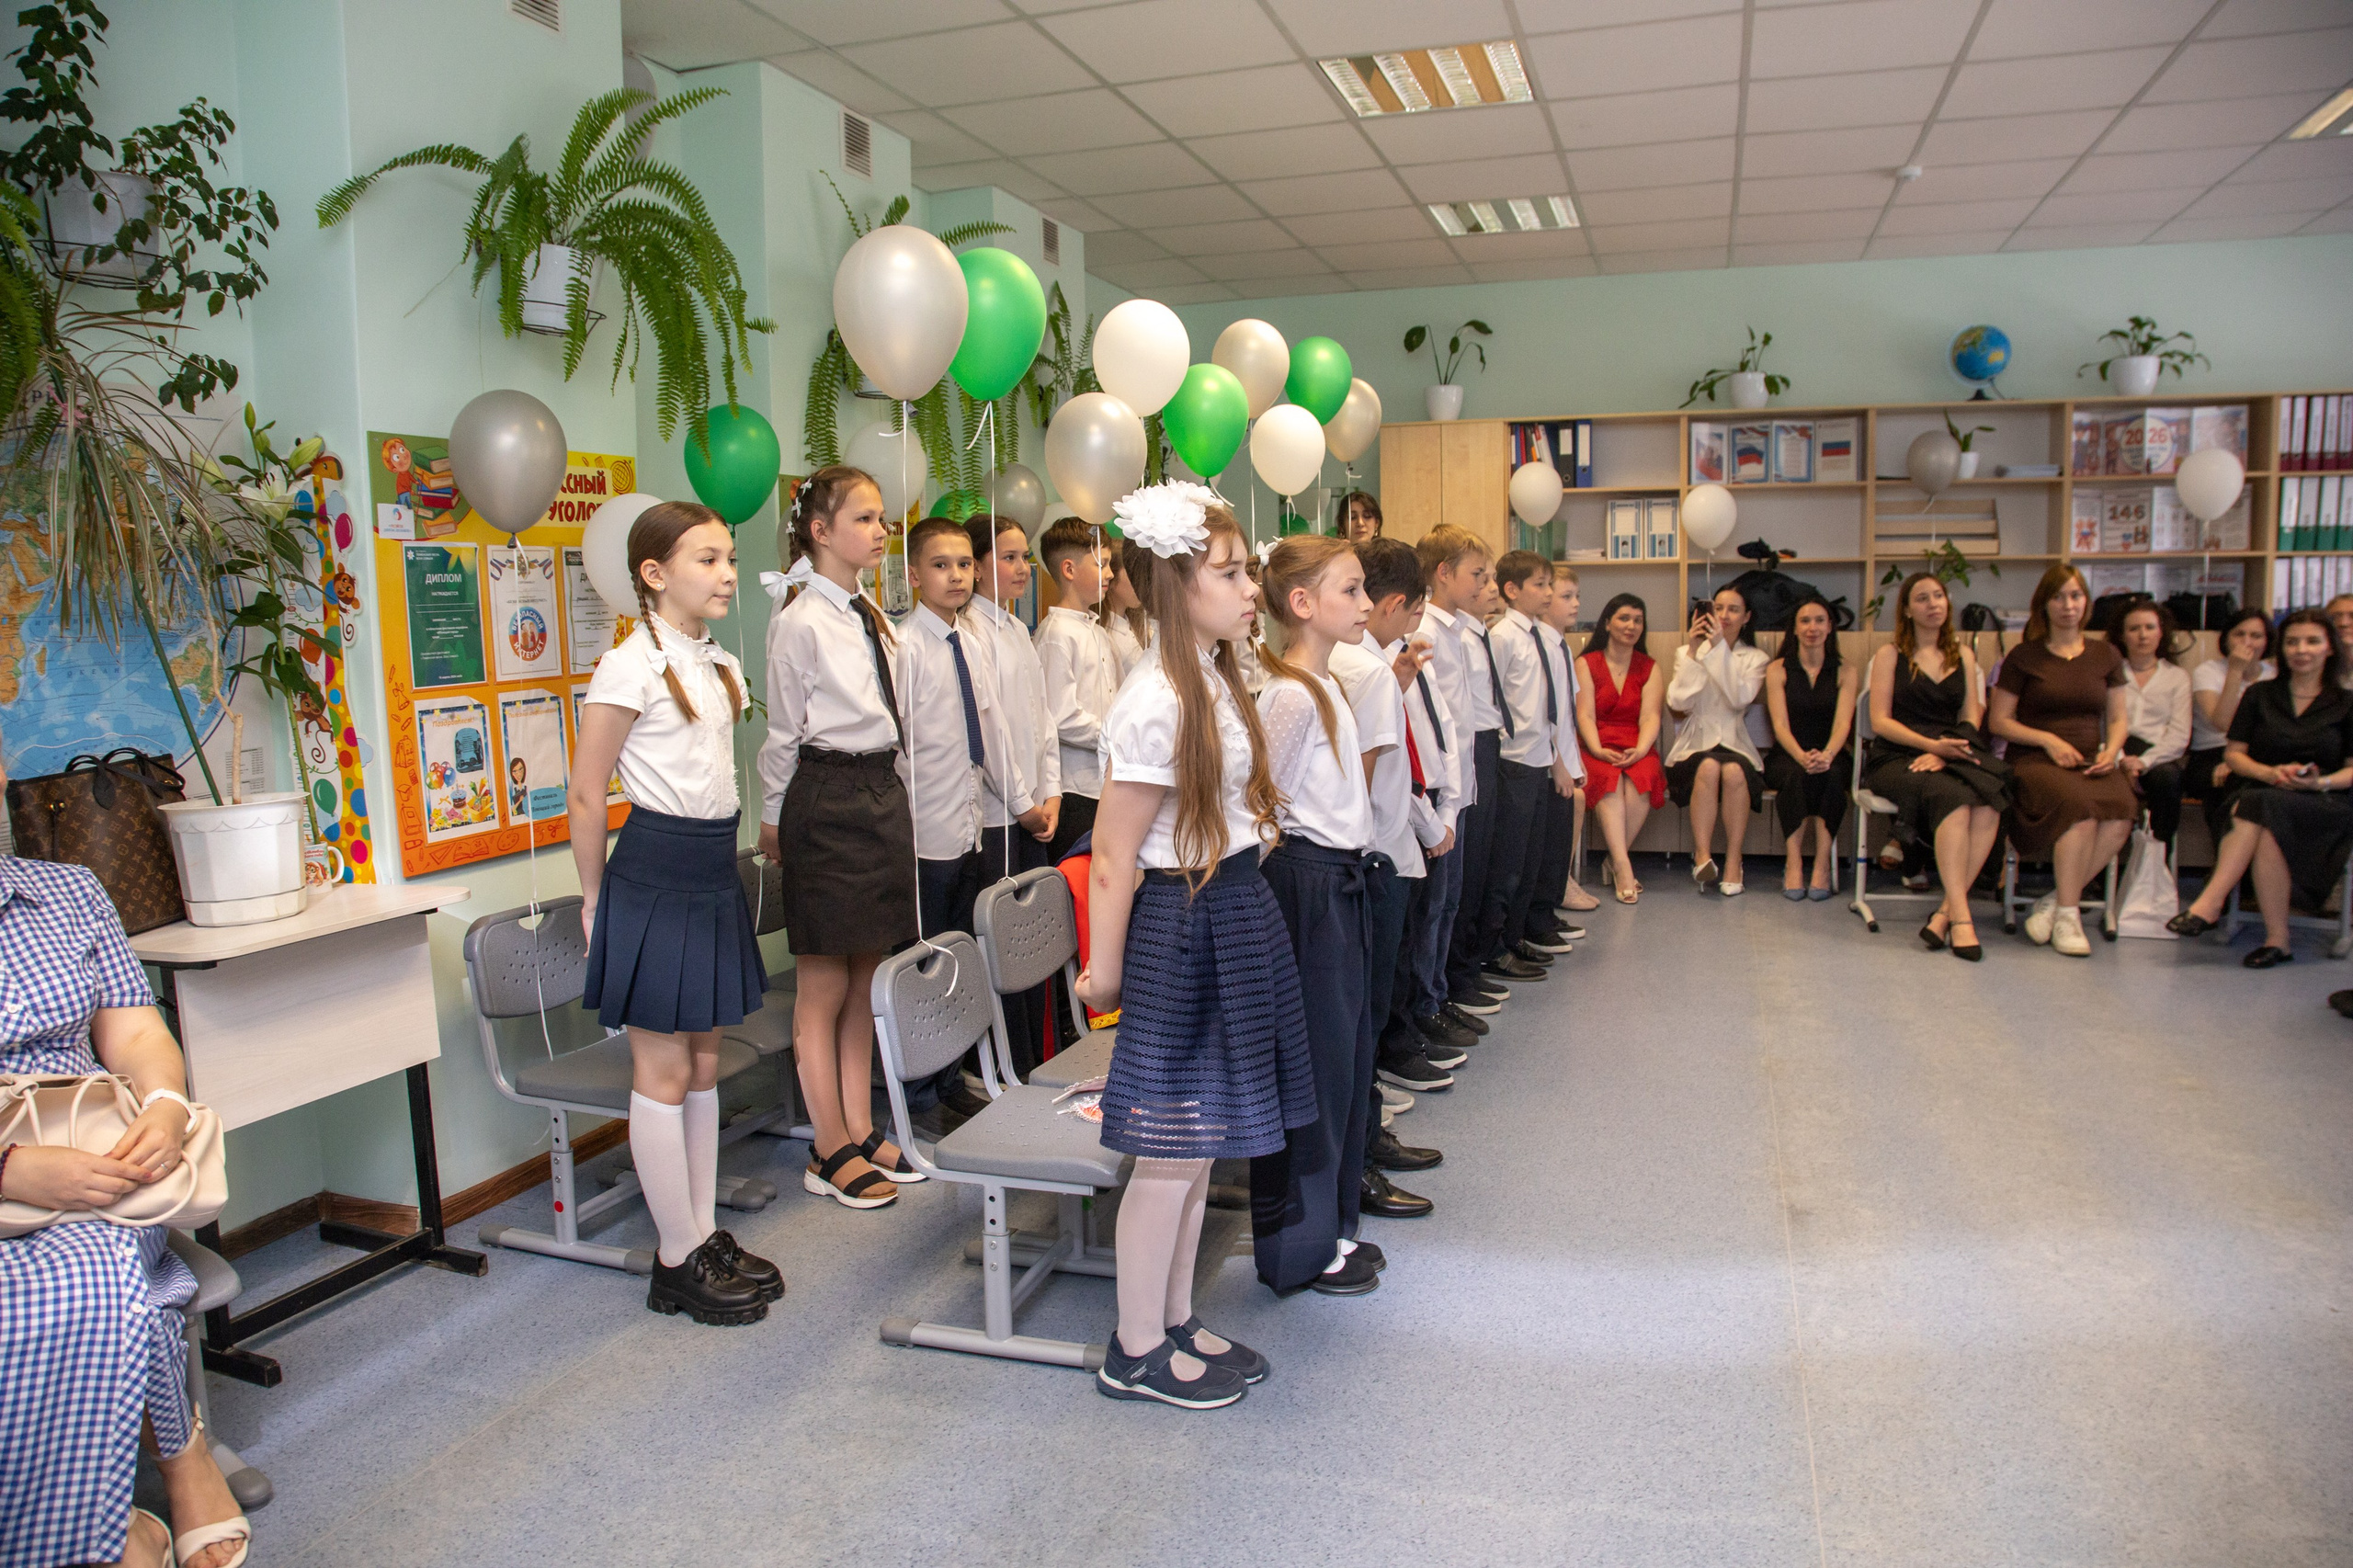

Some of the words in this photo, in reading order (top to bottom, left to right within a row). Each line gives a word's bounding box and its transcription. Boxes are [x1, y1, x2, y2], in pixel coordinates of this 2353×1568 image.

[560, 470, 607, 495] СНЫЙ
[548, 501, 603, 522] УГОЛО
[425, 574, 462, 585] ДИПЛОМ
[511, 610, 544, 631] БЕОПАСНЫЙ
